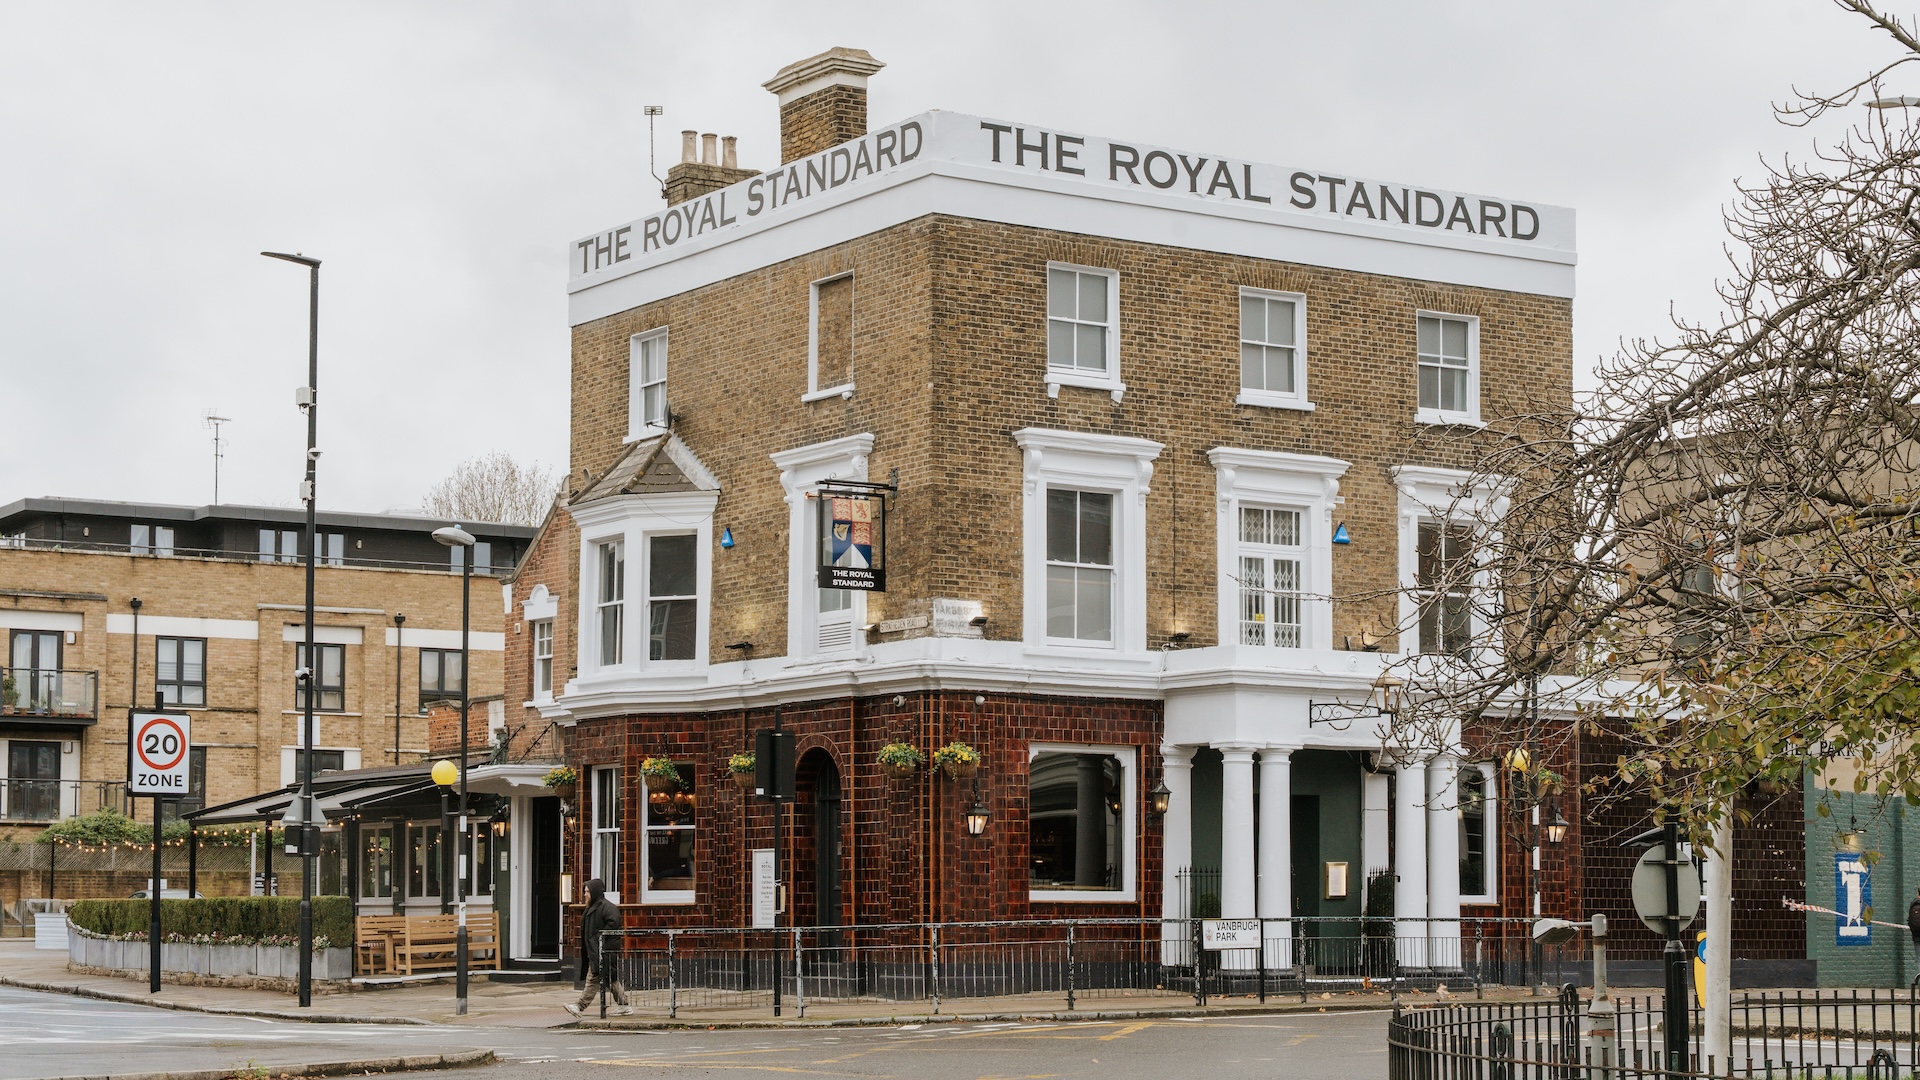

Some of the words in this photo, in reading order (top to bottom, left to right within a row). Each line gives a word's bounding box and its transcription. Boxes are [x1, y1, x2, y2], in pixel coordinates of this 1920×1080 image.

[980, 121, 1085, 177] THE
[1108, 143, 1272, 205] ROYAL
[1289, 171, 1540, 241] STANDARD
[577, 225, 631, 274] THE
[643, 191, 737, 254] ROYAL
[746, 120, 923, 217] STANDARD
[849, 570, 875, 579] ROYAL
[832, 579, 875, 588] STANDARD
[144, 734, 178, 755] 20
[138, 774, 183, 787] ZONE
[1216, 921, 1259, 931] VANBRUGH
[1216, 932, 1237, 941] PARK
